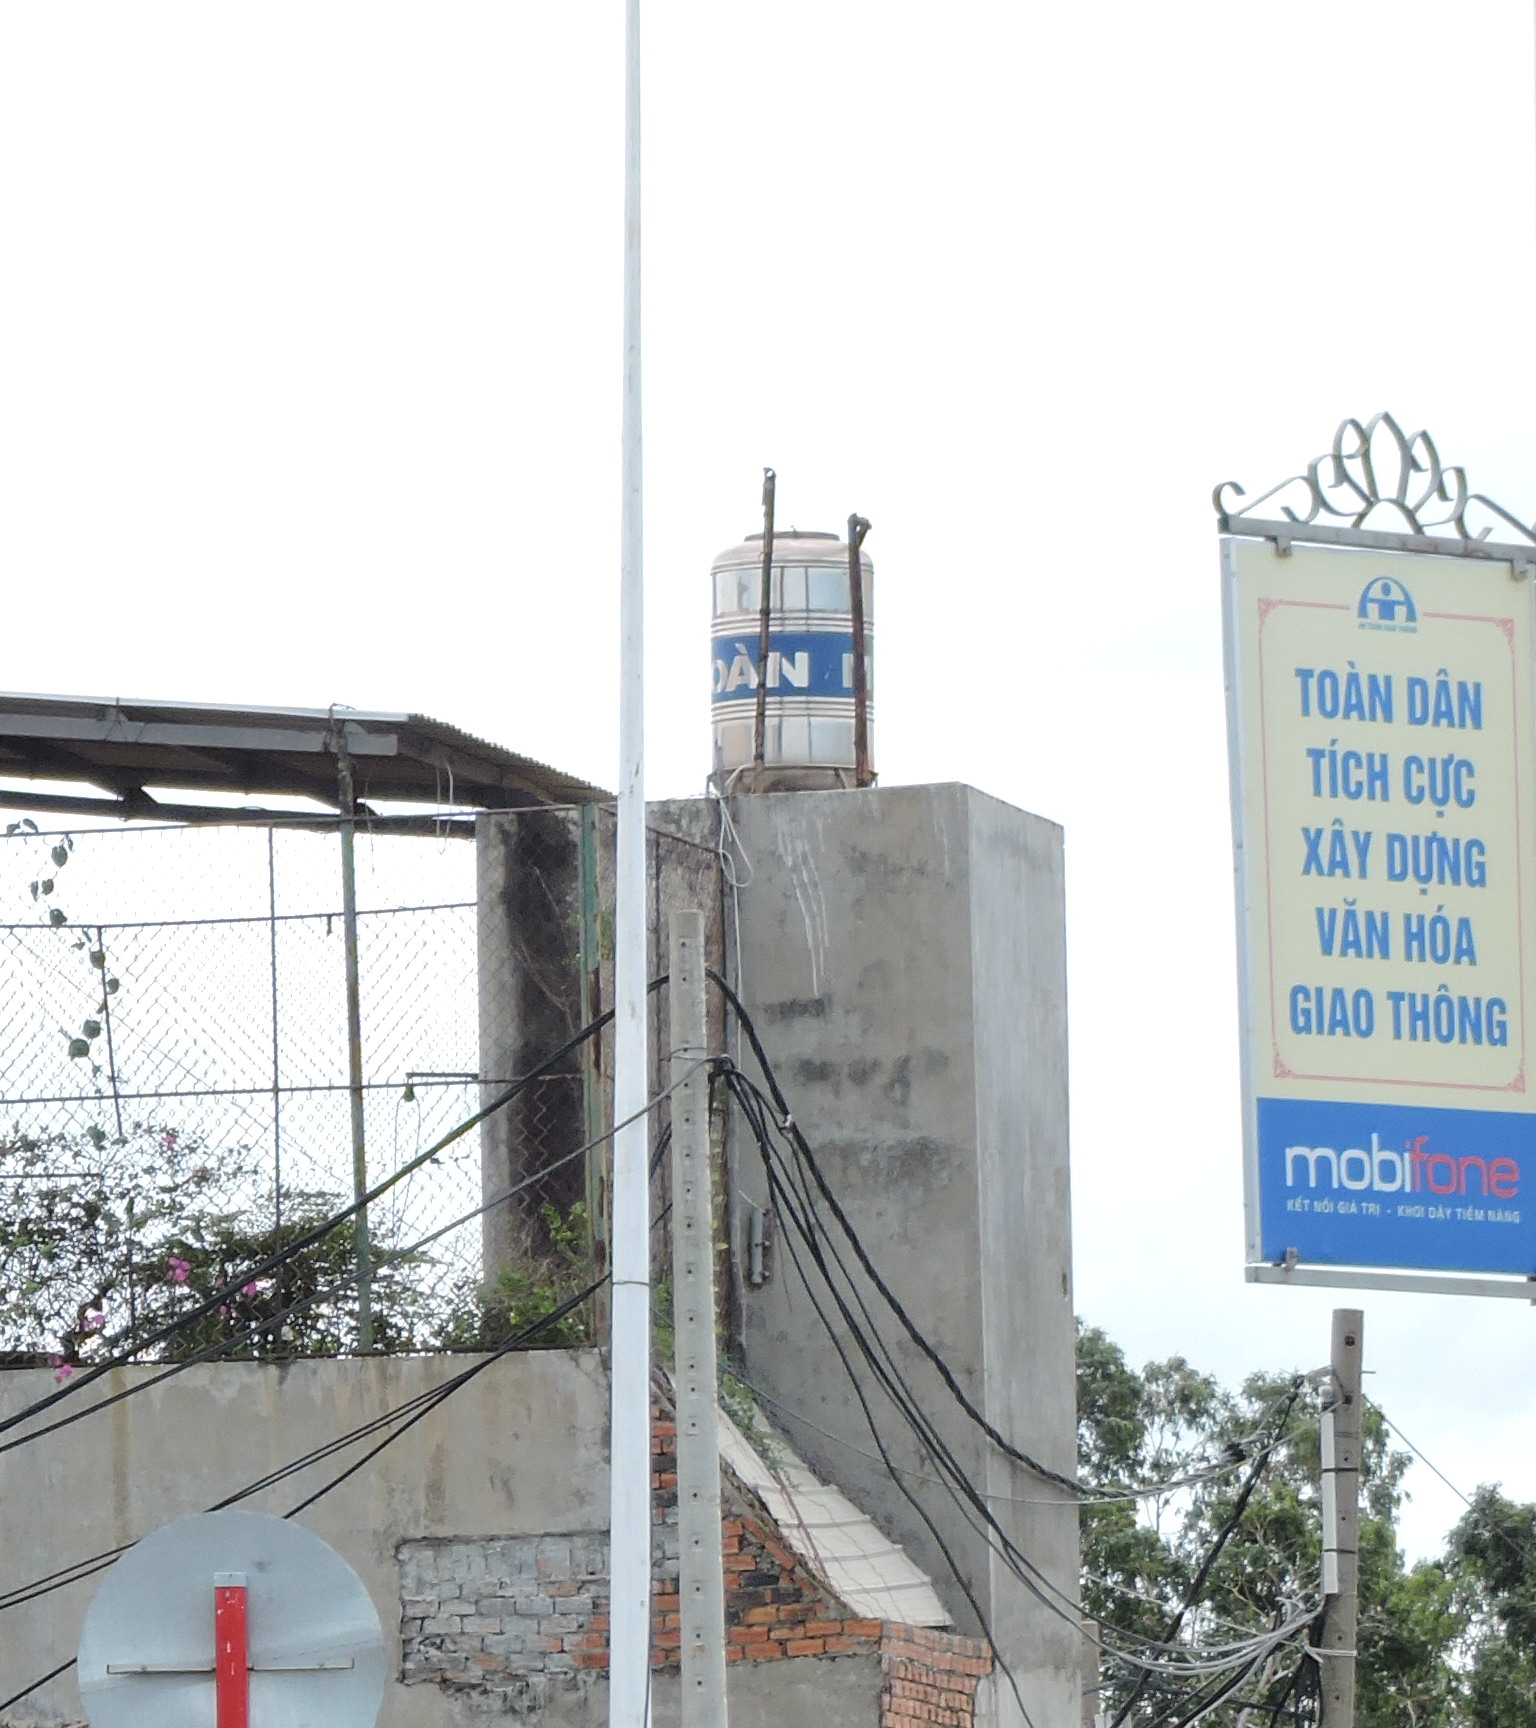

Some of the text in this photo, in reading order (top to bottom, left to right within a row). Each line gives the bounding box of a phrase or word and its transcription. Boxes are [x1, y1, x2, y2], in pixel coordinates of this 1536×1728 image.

[1295, 660, 1483, 730] TOÀN DÂN
[1306, 738, 1475, 818] TÍCH CỰC
[1301, 818, 1487, 895] XÂY DỰNG
[1315, 897, 1477, 966] VĂN HÓA
[1289, 983, 1508, 1047] GIAO THÔNG
[1285, 1132, 1520, 1198] mobifone
